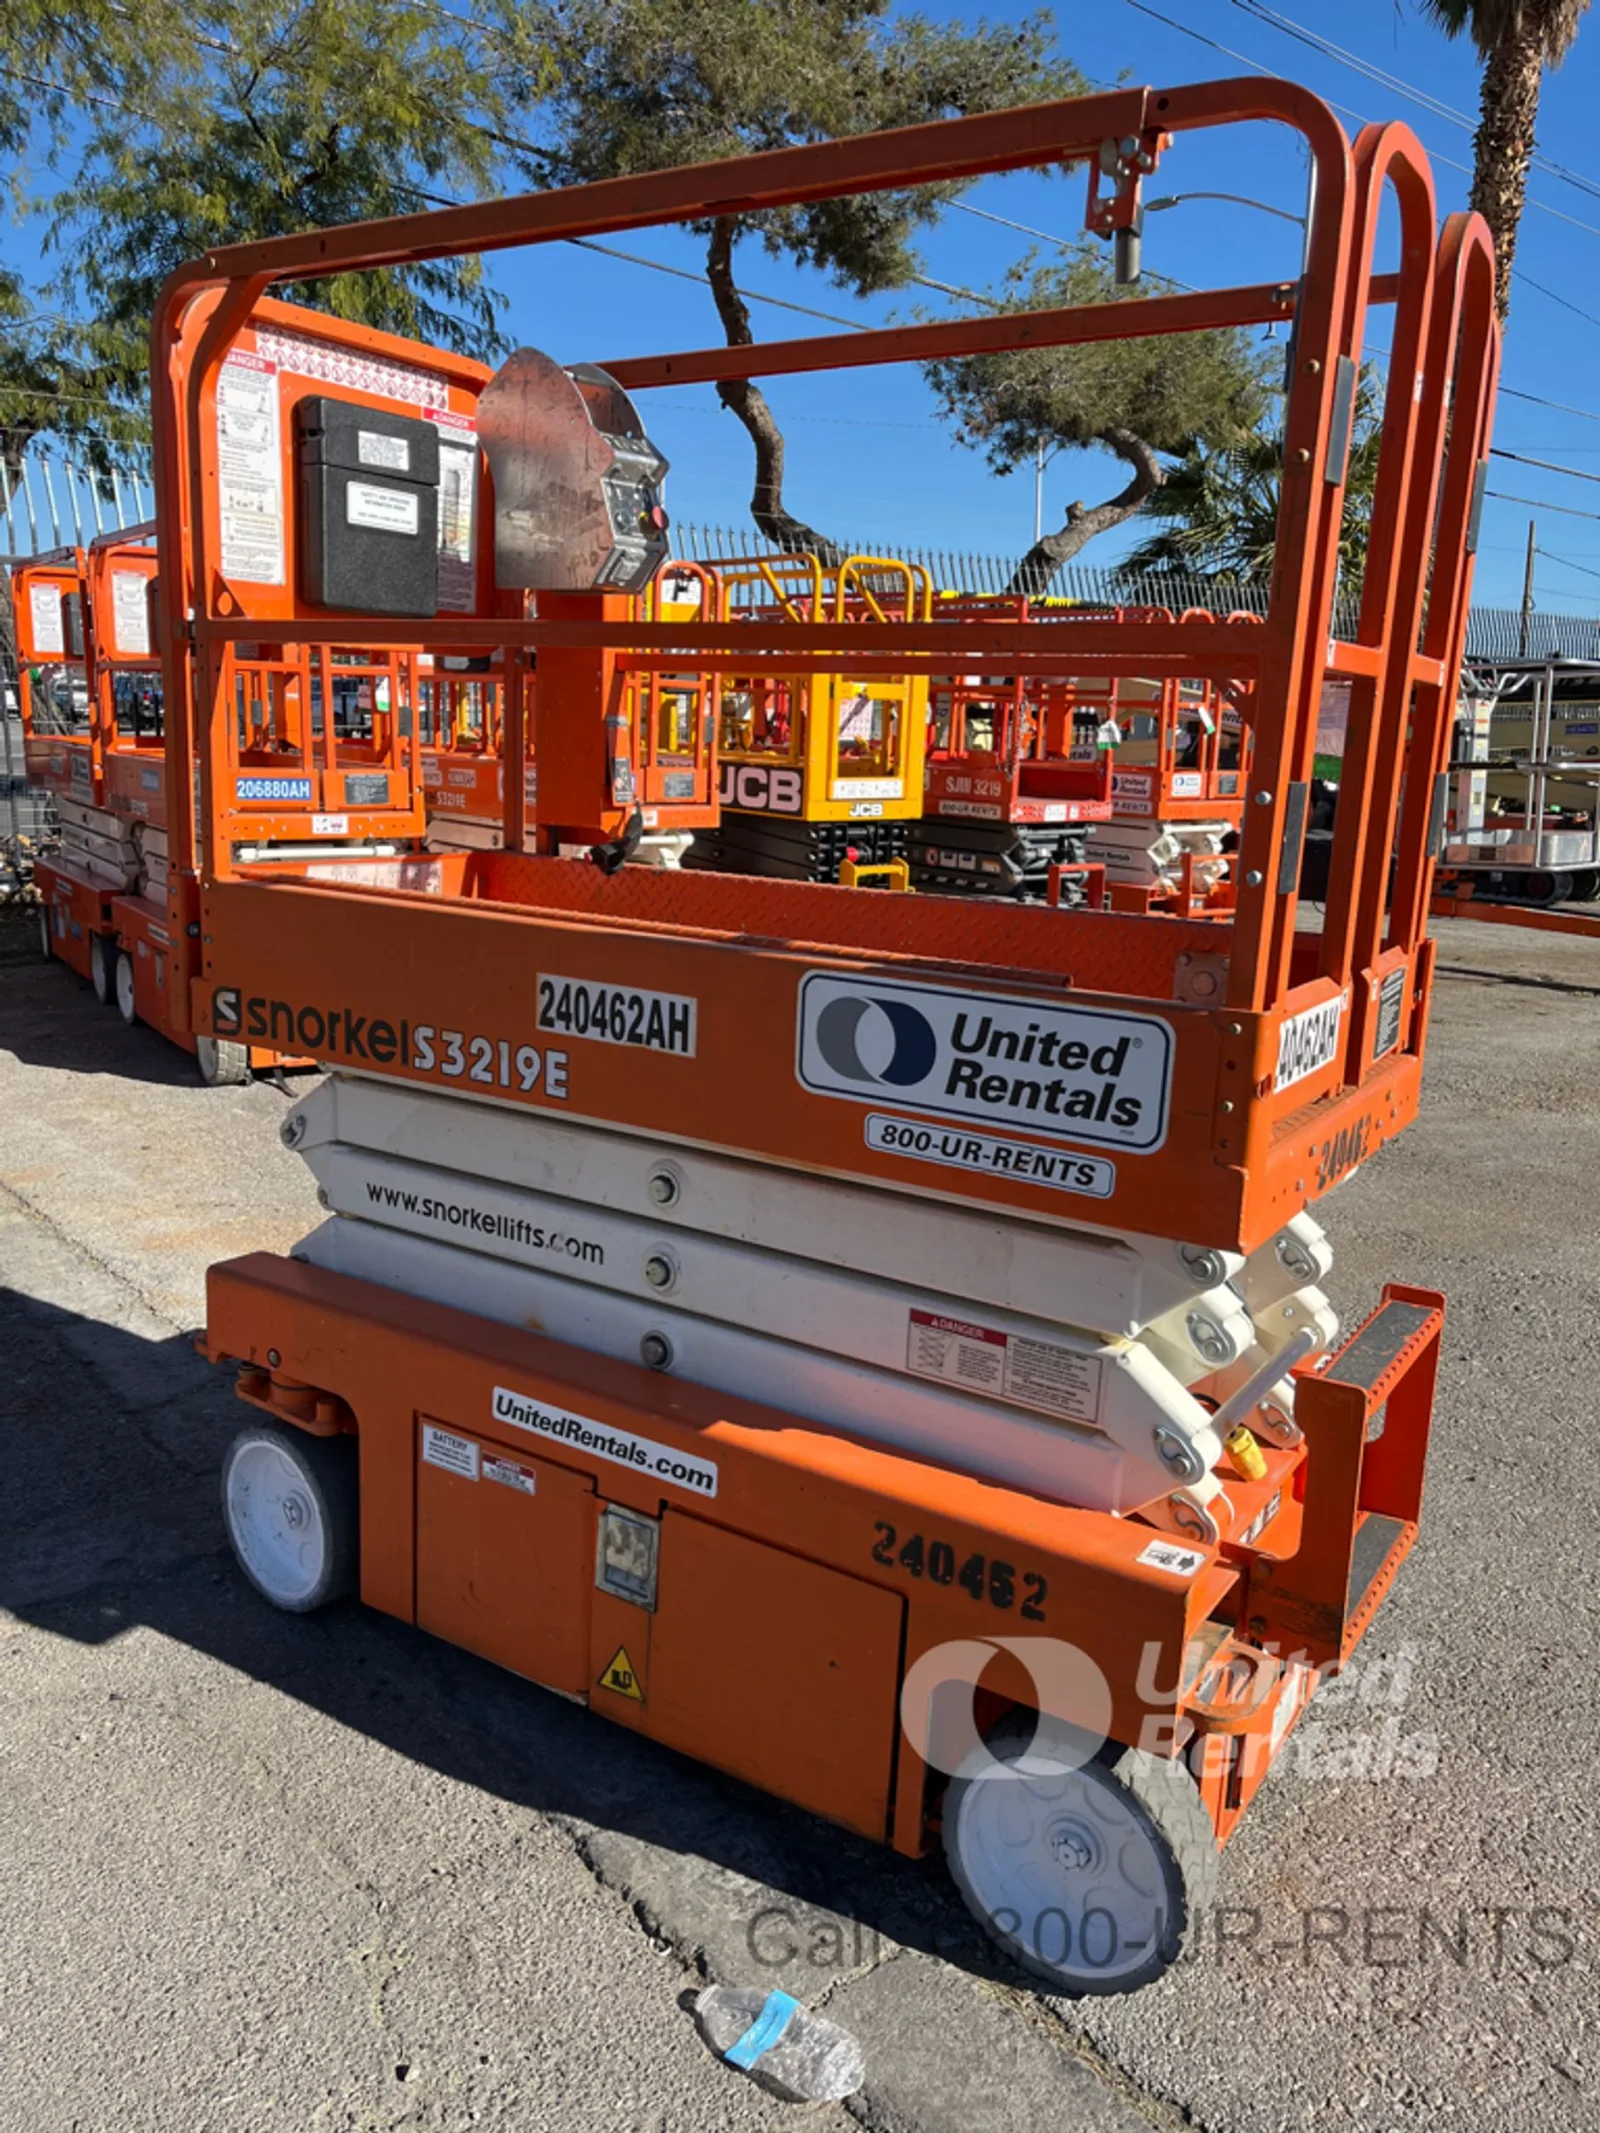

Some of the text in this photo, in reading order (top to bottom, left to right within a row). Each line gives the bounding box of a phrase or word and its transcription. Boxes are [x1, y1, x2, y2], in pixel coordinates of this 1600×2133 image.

[237, 779, 311, 798] 206880AH
[719, 765, 800, 812] JCB
[849, 803, 883, 817] JCB
[973, 779, 1001, 797] 3219
[248, 997, 409, 1067] snorkel
[413, 1025, 569, 1099] S3219E
[538, 979, 690, 1054] 240462AH
[1276, 1003, 1340, 1087] 40462AH
[944, 1057, 1143, 1129] Rentals
[880, 1124, 1097, 1187] 800-UR-RENTS
[366, 1182, 605, 1266] www.snorkellifts.com
[939, 1318, 985, 1340] DANGER
[432, 1430, 469, 1451] BATTERY
[496, 1394, 714, 1490] UnitedRentals.com
